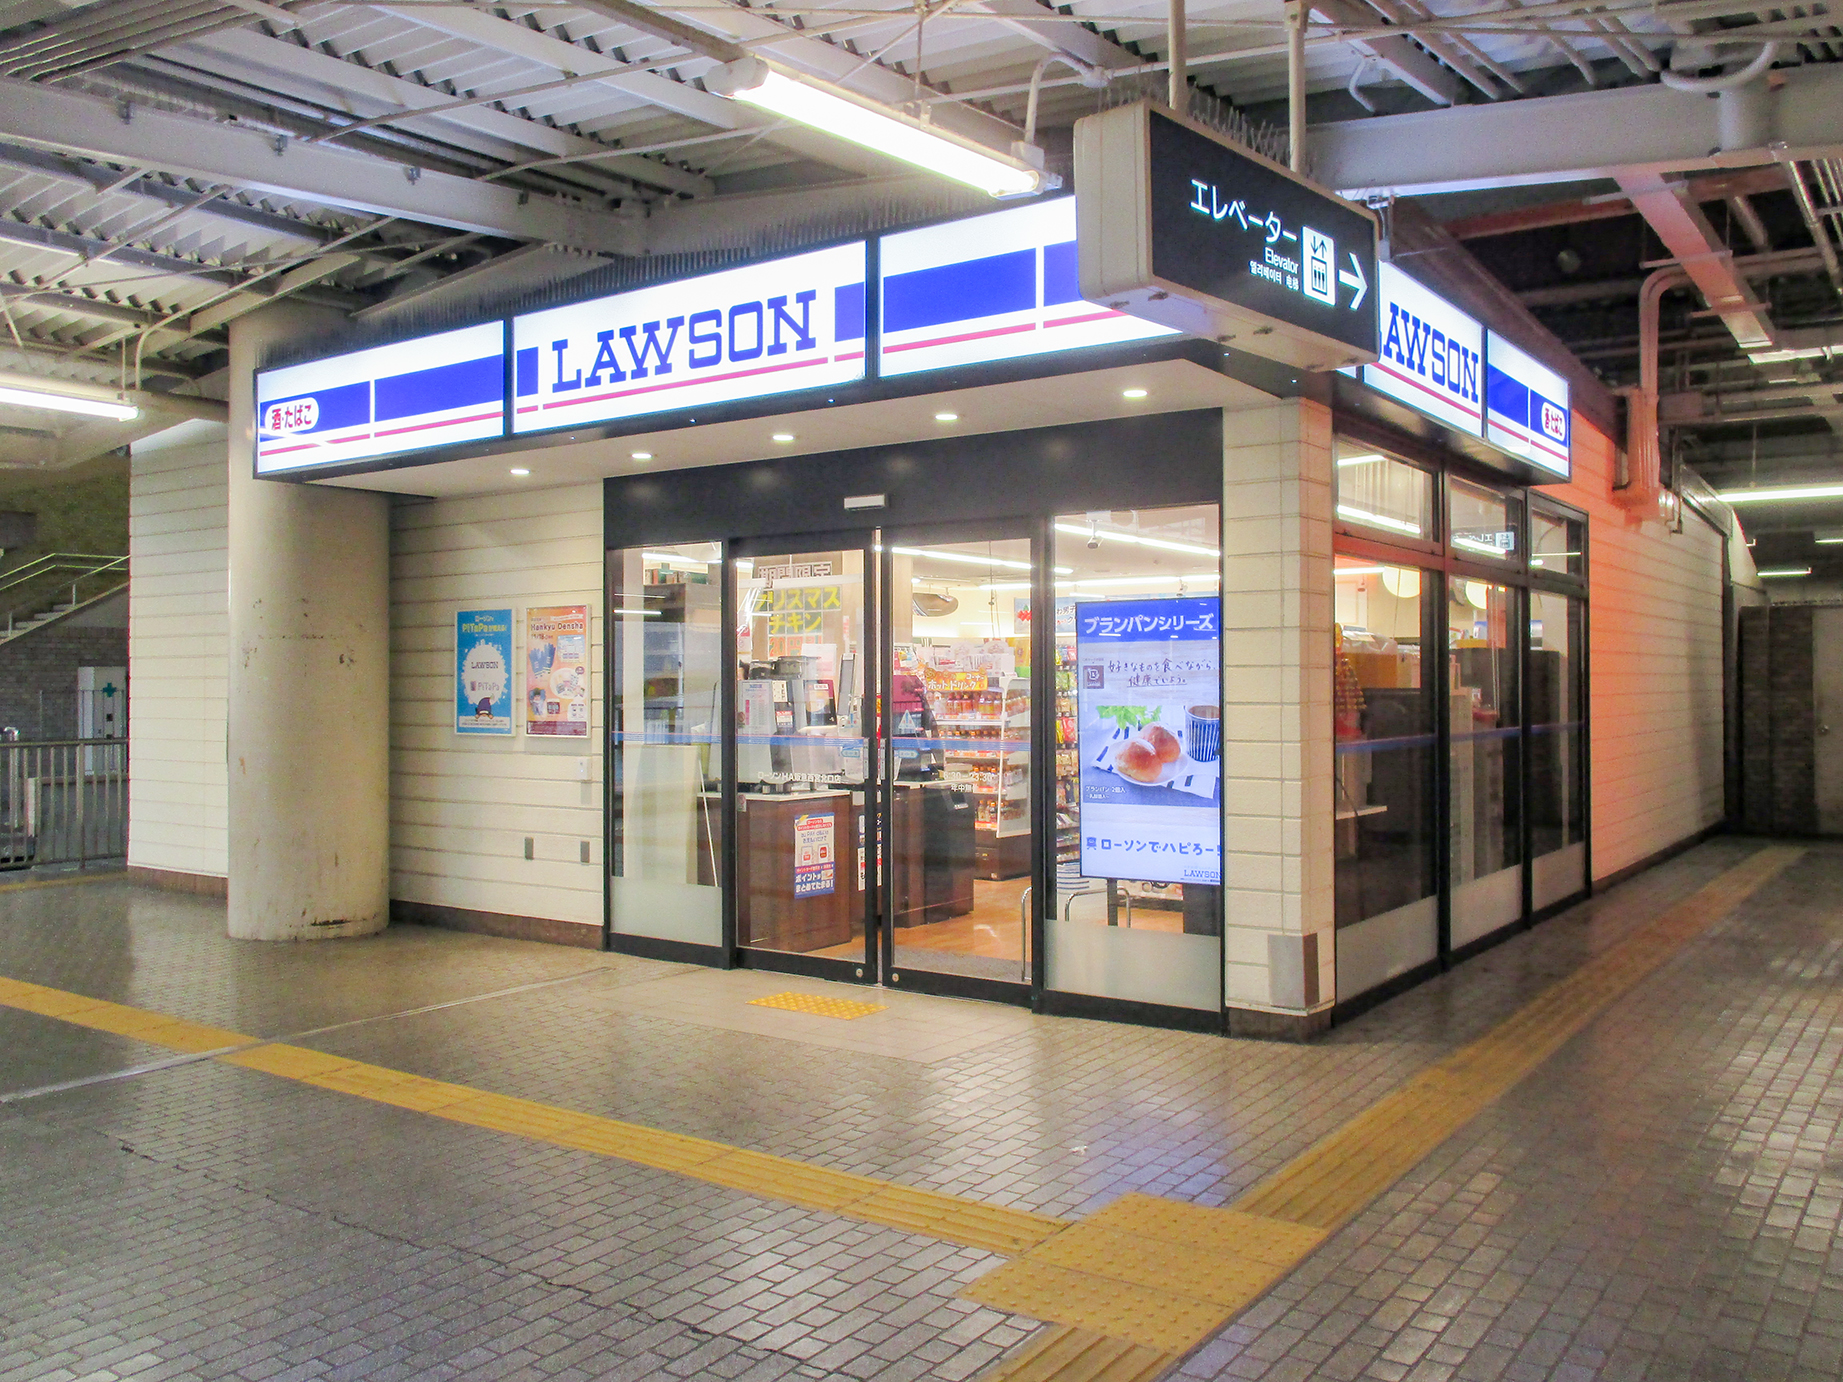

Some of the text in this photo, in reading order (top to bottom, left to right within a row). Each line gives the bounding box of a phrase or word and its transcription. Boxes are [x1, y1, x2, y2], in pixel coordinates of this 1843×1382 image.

[1190, 178, 1299, 243] エレベーター
[1264, 246, 1299, 275] Elevator
[552, 289, 817, 393] LAWSON
[1379, 301, 1479, 404] AWSON
[530, 621, 584, 632] Hankyu Densha
[769, 612, 823, 634] チキン
[1084, 612, 1215, 634] ブランパンシリーズ
[471, 661, 499, 669] LAWSON
[1107, 658, 1217, 673] 好きなものを食べながら、
[477, 681, 500, 692] PiTaPa
[1128, 675, 1187, 687] 健康でいよう。
[1101, 839, 1221, 856] ローソンでハピろー!
[1183, 869, 1220, 879] LAWSON
